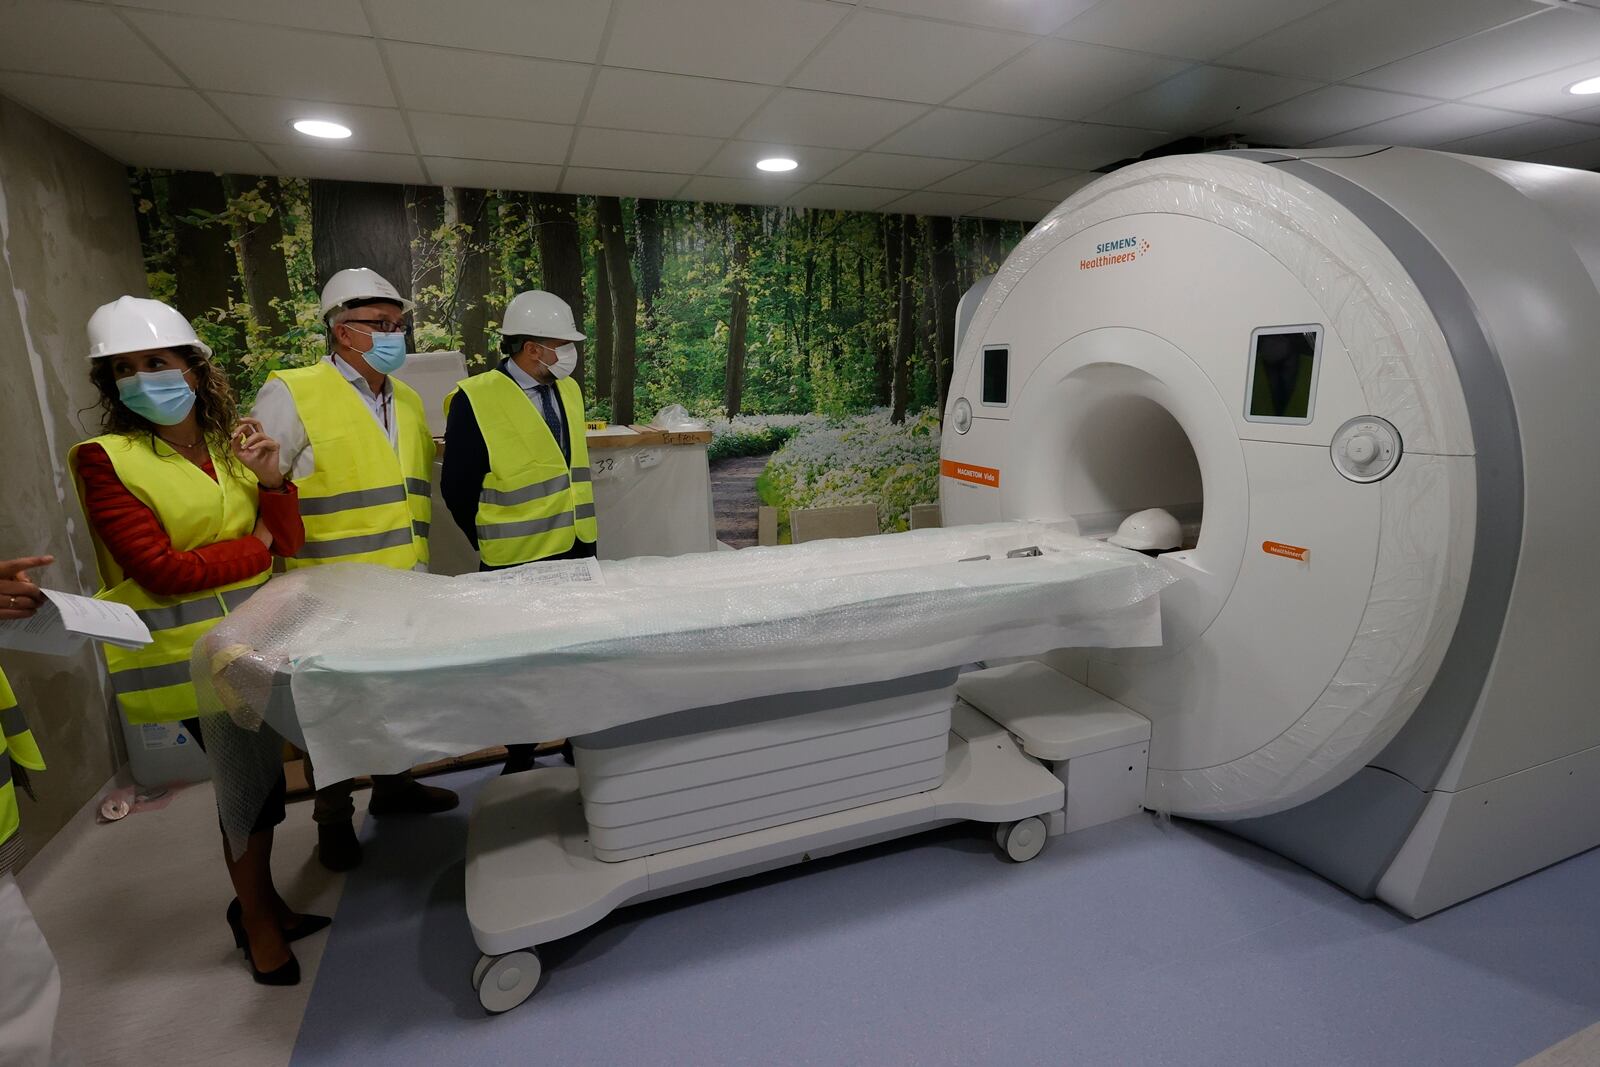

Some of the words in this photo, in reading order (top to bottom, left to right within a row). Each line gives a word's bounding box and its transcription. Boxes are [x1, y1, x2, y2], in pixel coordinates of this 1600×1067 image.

[1096, 236, 1137, 254] SIEMENS
[1080, 251, 1136, 271] Healthineers
[957, 467, 983, 478] MAGNETOM
[1270, 546, 1303, 558] Healthineer
